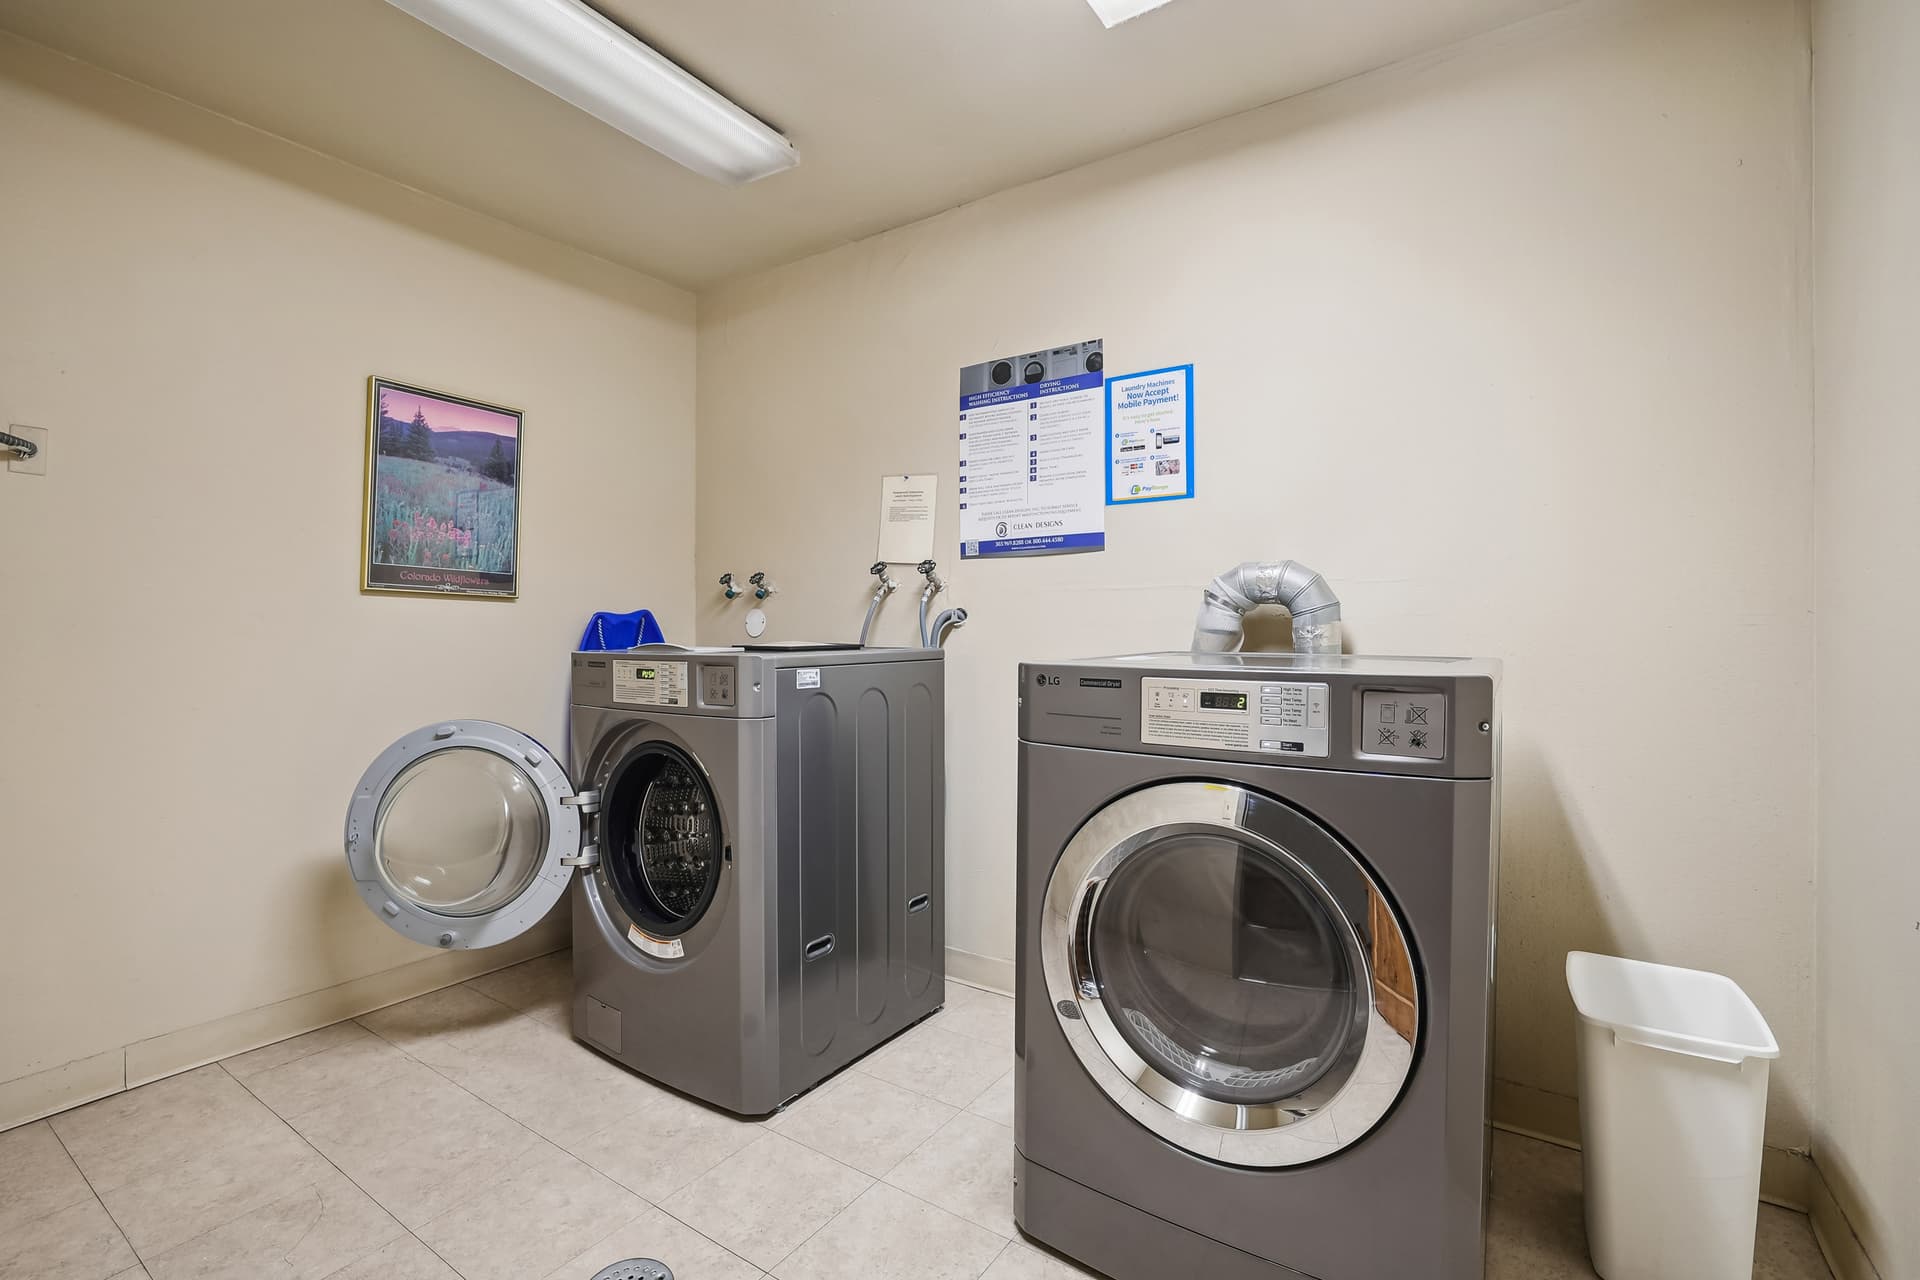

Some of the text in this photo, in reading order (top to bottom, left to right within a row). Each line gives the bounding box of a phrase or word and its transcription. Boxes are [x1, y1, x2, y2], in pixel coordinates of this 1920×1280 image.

[1040, 380, 1061, 388] DRYING
[1040, 384, 1080, 394] INSTRUCTIONS
[1121, 379, 1175, 392] Laundry Machines
[968, 390, 1010, 401] HIGH EFFICIENCY
[992, 392, 1029, 403] INSTRUCTIONS
[1145, 387, 1169, 397] Accept
[1118, 394, 1179, 410] Mobile Payment!
[1035, 520, 1063, 528] DESIGNS
[400, 571, 490, 585] Colorado Wildflowers
[1048, 676, 1060, 685] LG
[1237, 697, 1245, 708] 2
